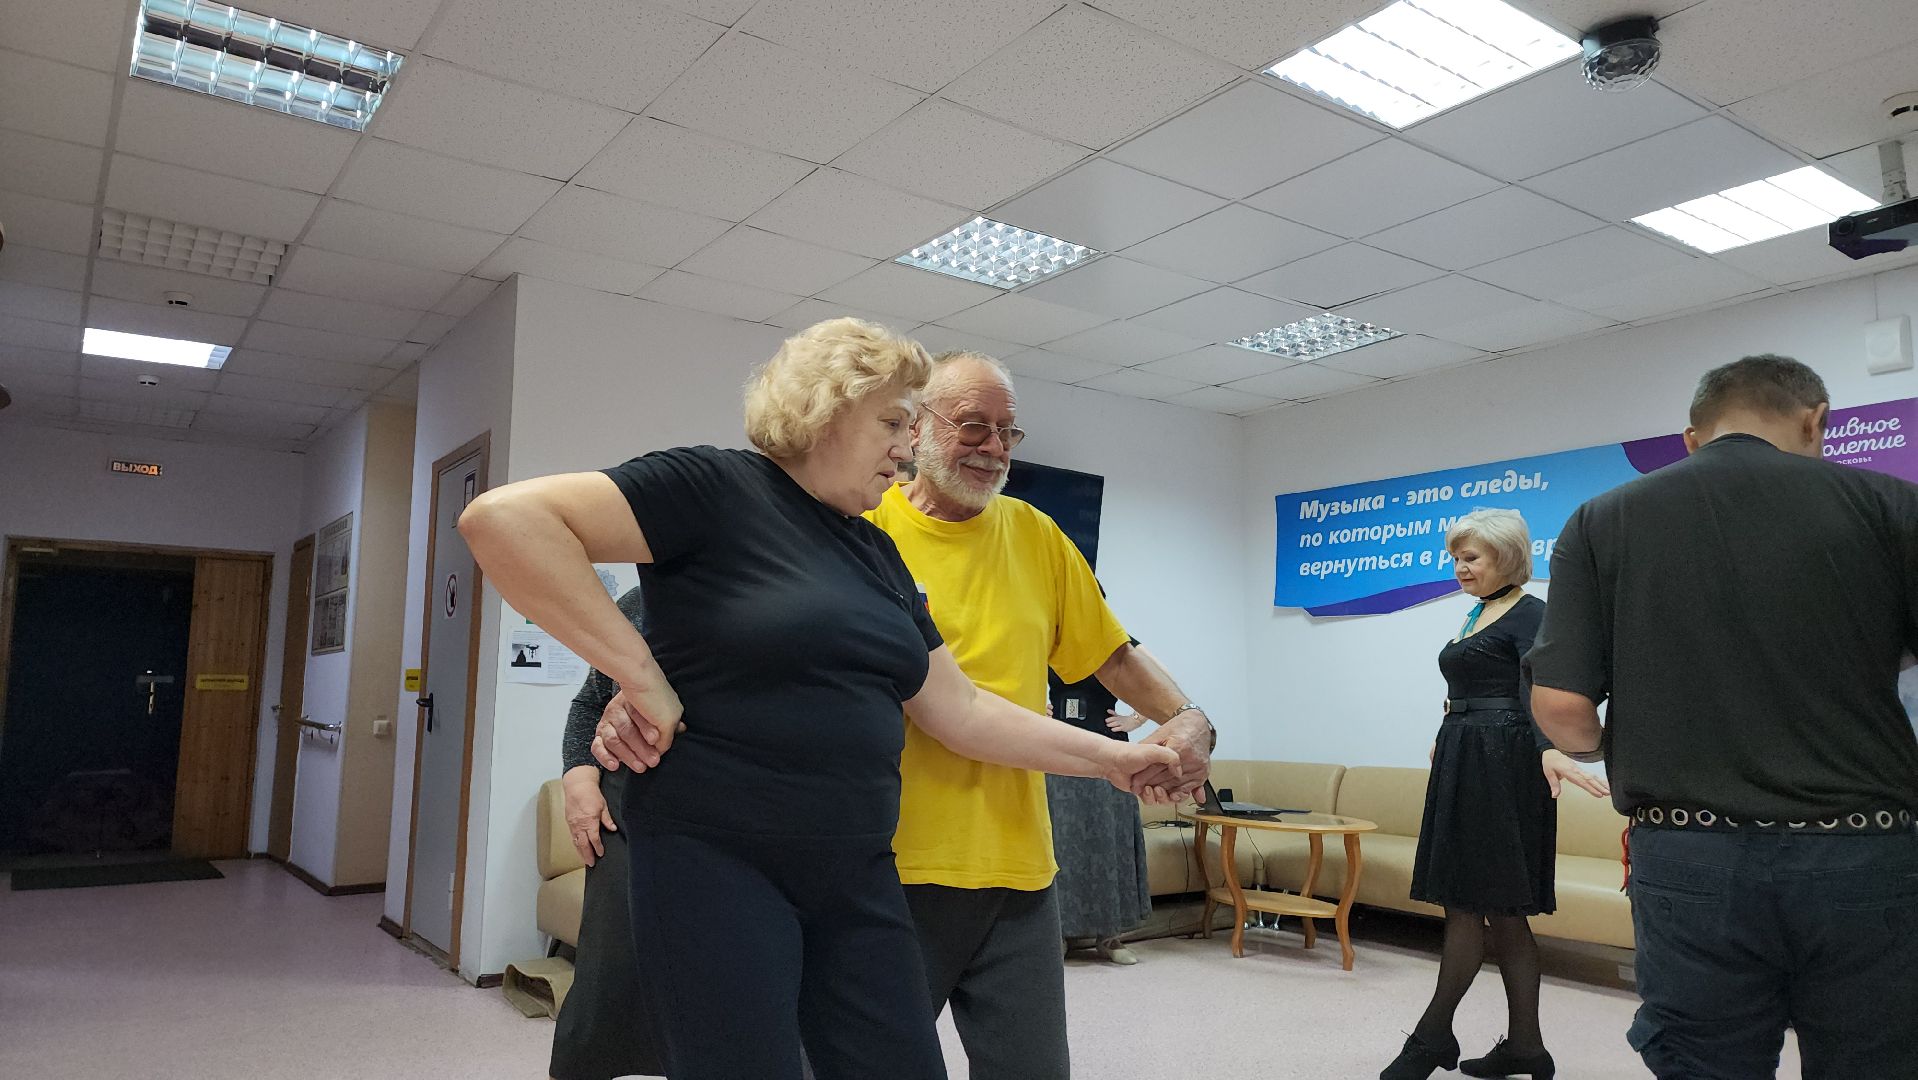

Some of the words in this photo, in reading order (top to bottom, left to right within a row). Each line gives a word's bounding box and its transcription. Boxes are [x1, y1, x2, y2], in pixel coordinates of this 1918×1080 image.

[1823, 416, 1902, 440] ивное
[1822, 434, 1907, 457] олетие
[112, 461, 159, 476] ВЫХОД
[1299, 494, 1386, 523] Музыка
[1405, 485, 1455, 506] это
[1460, 469, 1550, 498] следы,
[1299, 532, 1323, 548] по
[1328, 519, 1433, 545] которым
[1299, 551, 1415, 580] вернуться
[1419, 550, 1433, 566] в
